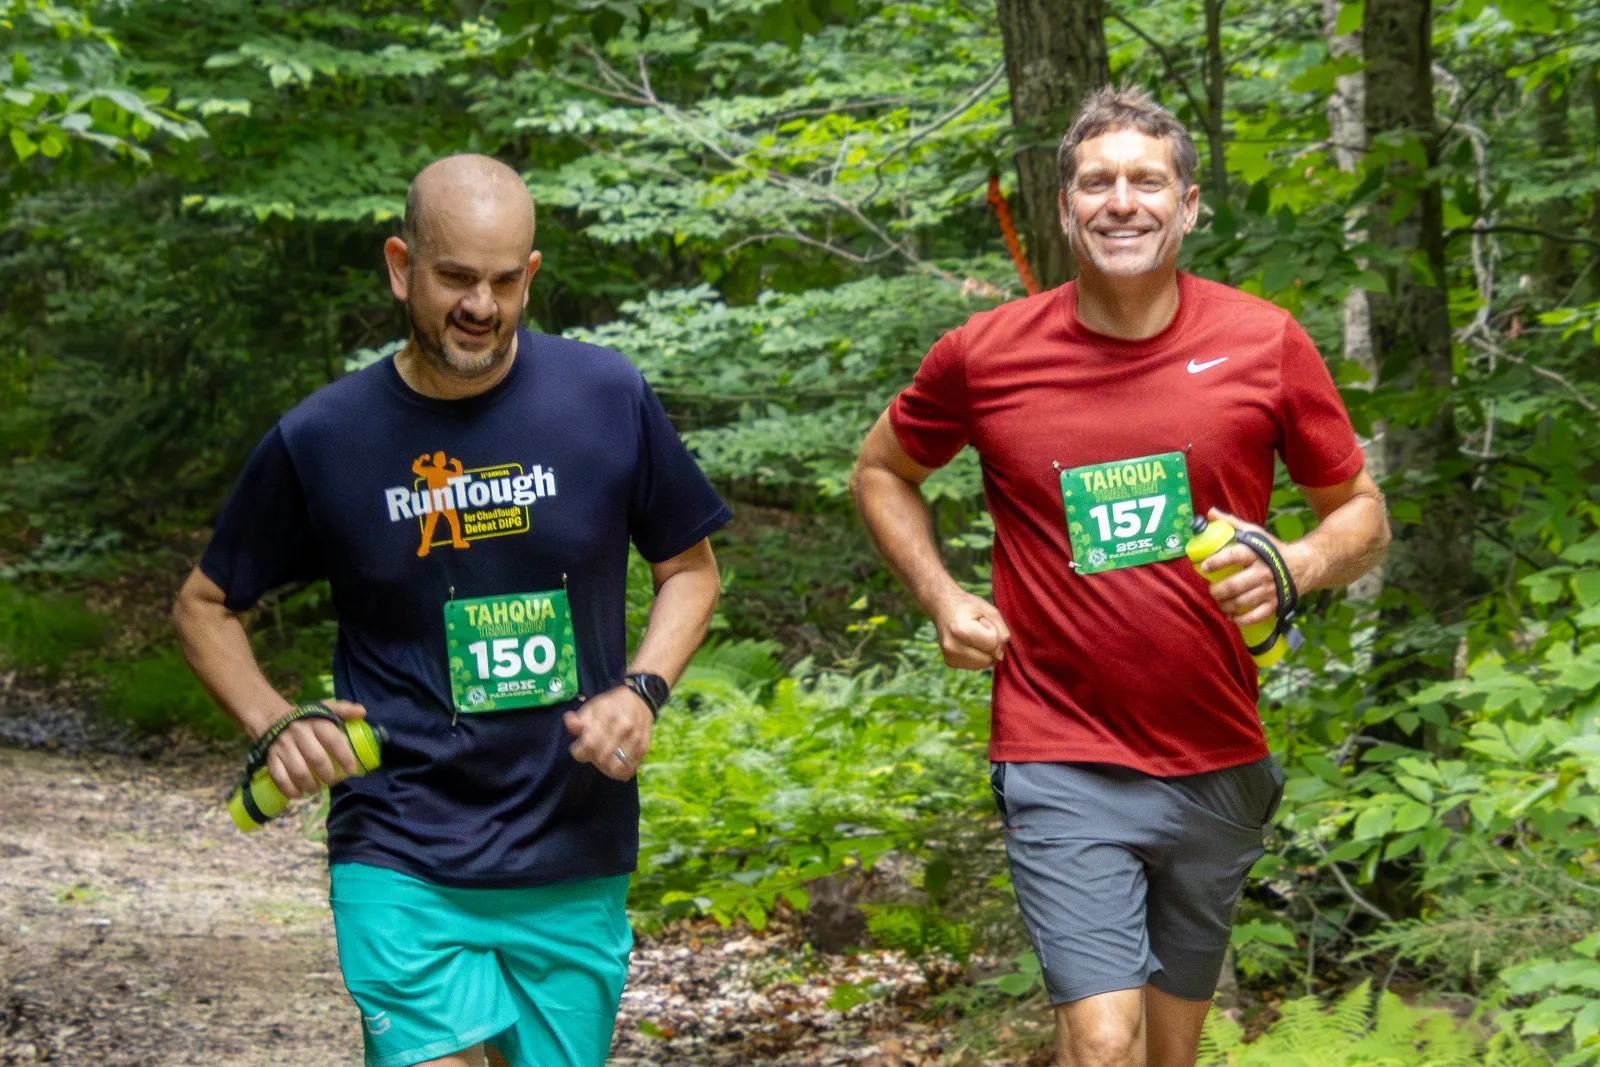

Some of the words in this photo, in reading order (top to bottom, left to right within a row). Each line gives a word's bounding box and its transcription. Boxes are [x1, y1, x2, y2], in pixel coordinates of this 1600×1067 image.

[1080, 461, 1167, 492] TAHQUA
[464, 513, 476, 523] for
[476, 506, 521, 521] ChadTough
[465, 519, 497, 535] Defeat
[498, 516, 522, 529] DIPG
[1089, 494, 1167, 542] 157
[1116, 537, 1153, 552] 25K
[464, 597, 556, 626] TAHQUA
[468, 634, 556, 679] 150
